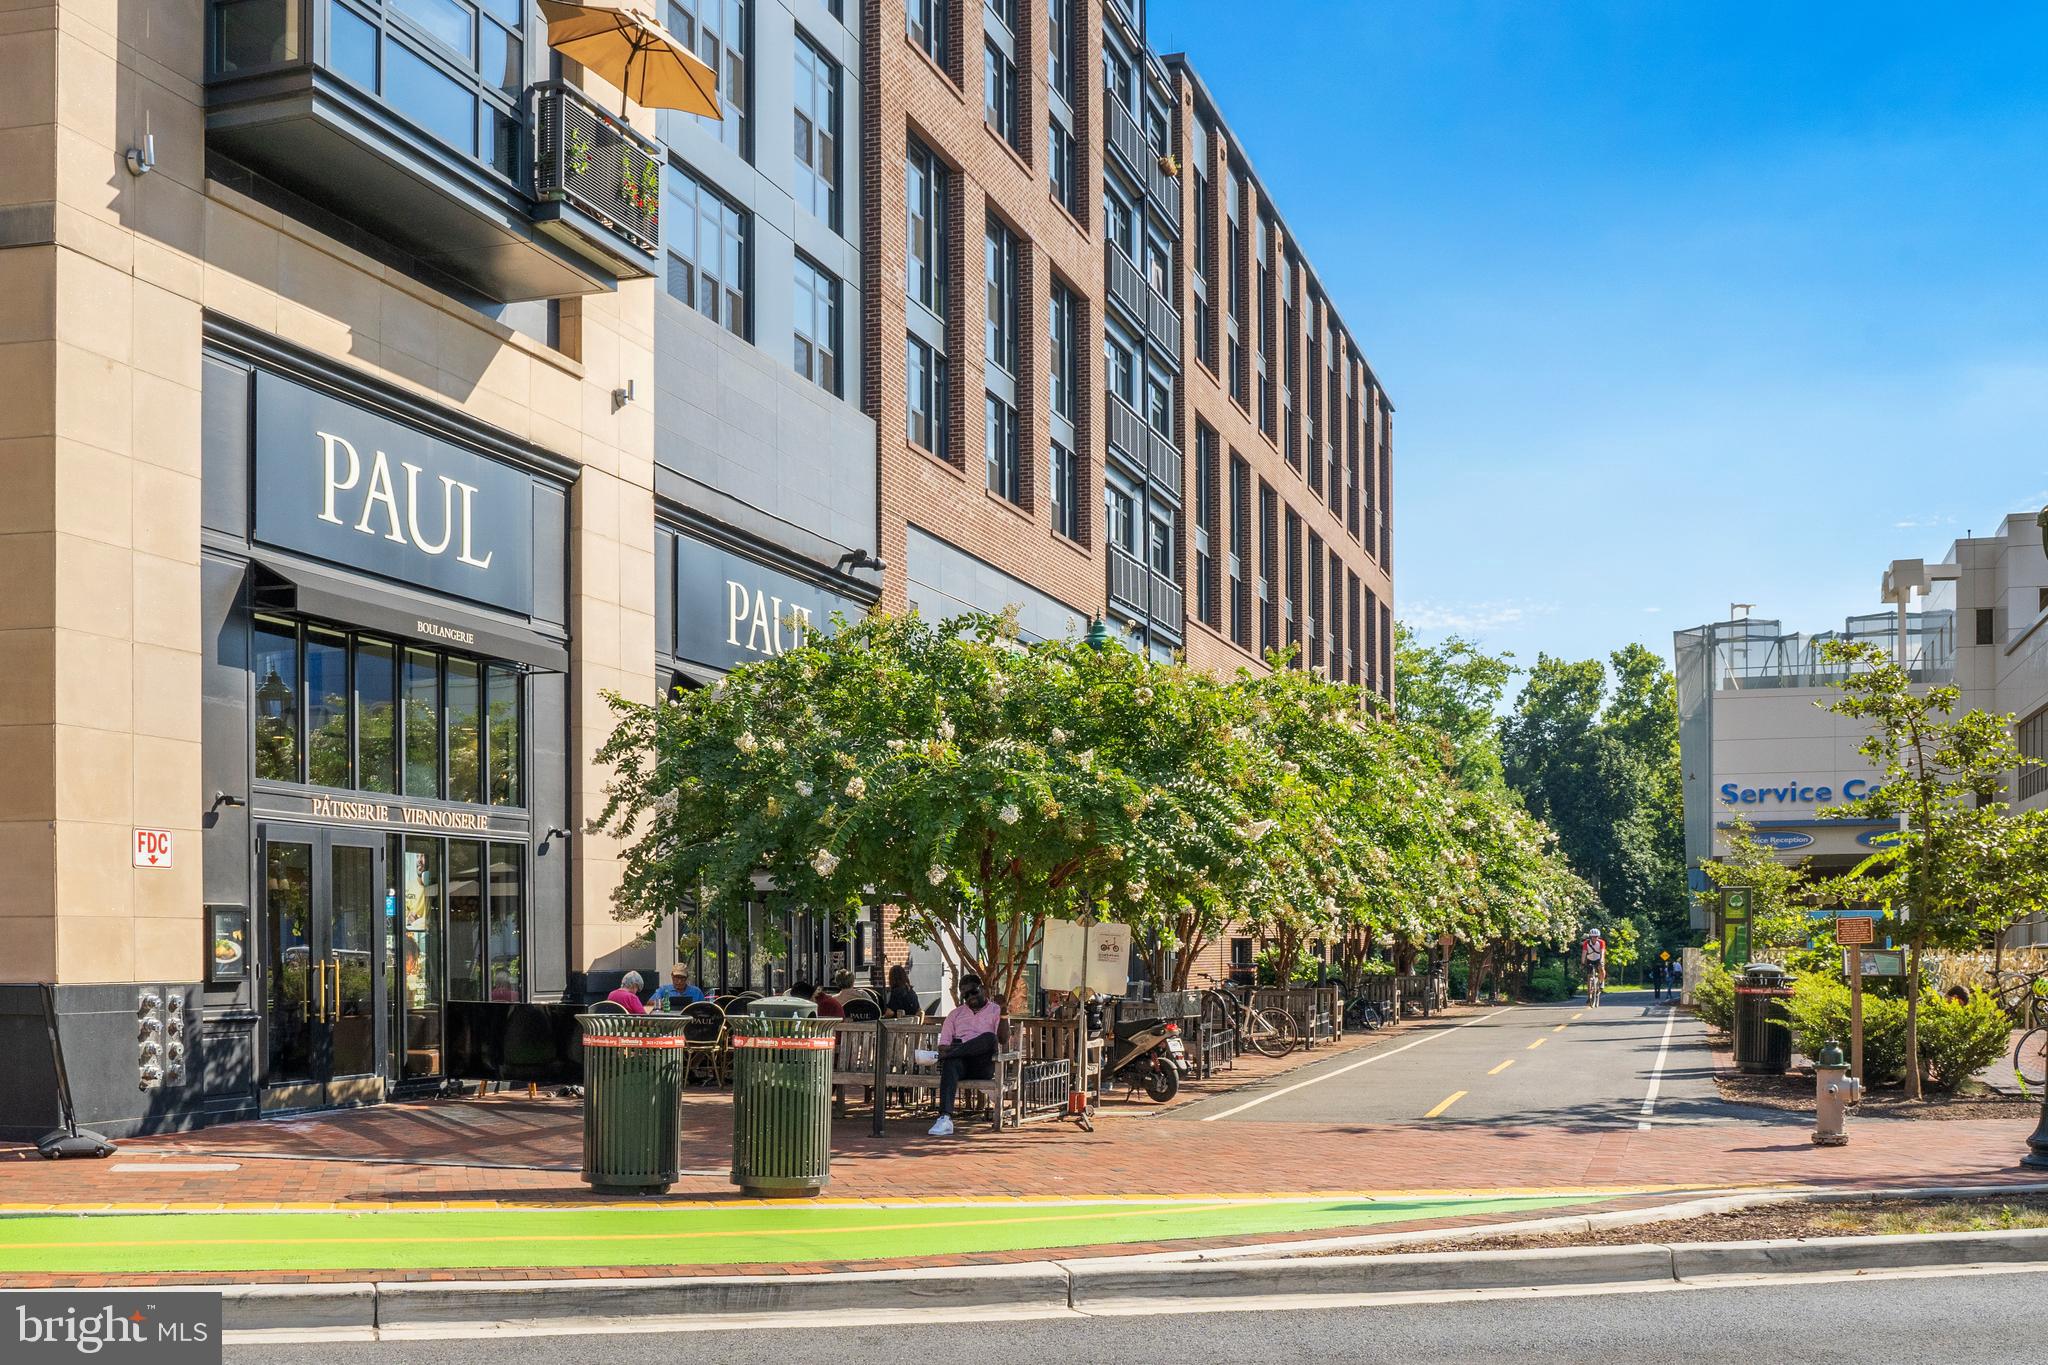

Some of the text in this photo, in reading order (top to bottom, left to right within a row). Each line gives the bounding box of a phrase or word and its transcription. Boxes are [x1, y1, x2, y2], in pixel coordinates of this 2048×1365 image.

[316, 431, 493, 569] PAUL
[416, 620, 475, 645] BOULANGERIE
[1720, 780, 1833, 804] Service
[312, 794, 488, 830] PÂTISSERIE VIENNOISERIE
[138, 831, 168, 855] FDC
[1769, 835, 1809, 845] Reception
[690, 1017, 714, 1025] PAUL
[850, 1012, 869, 1020] PAUL
